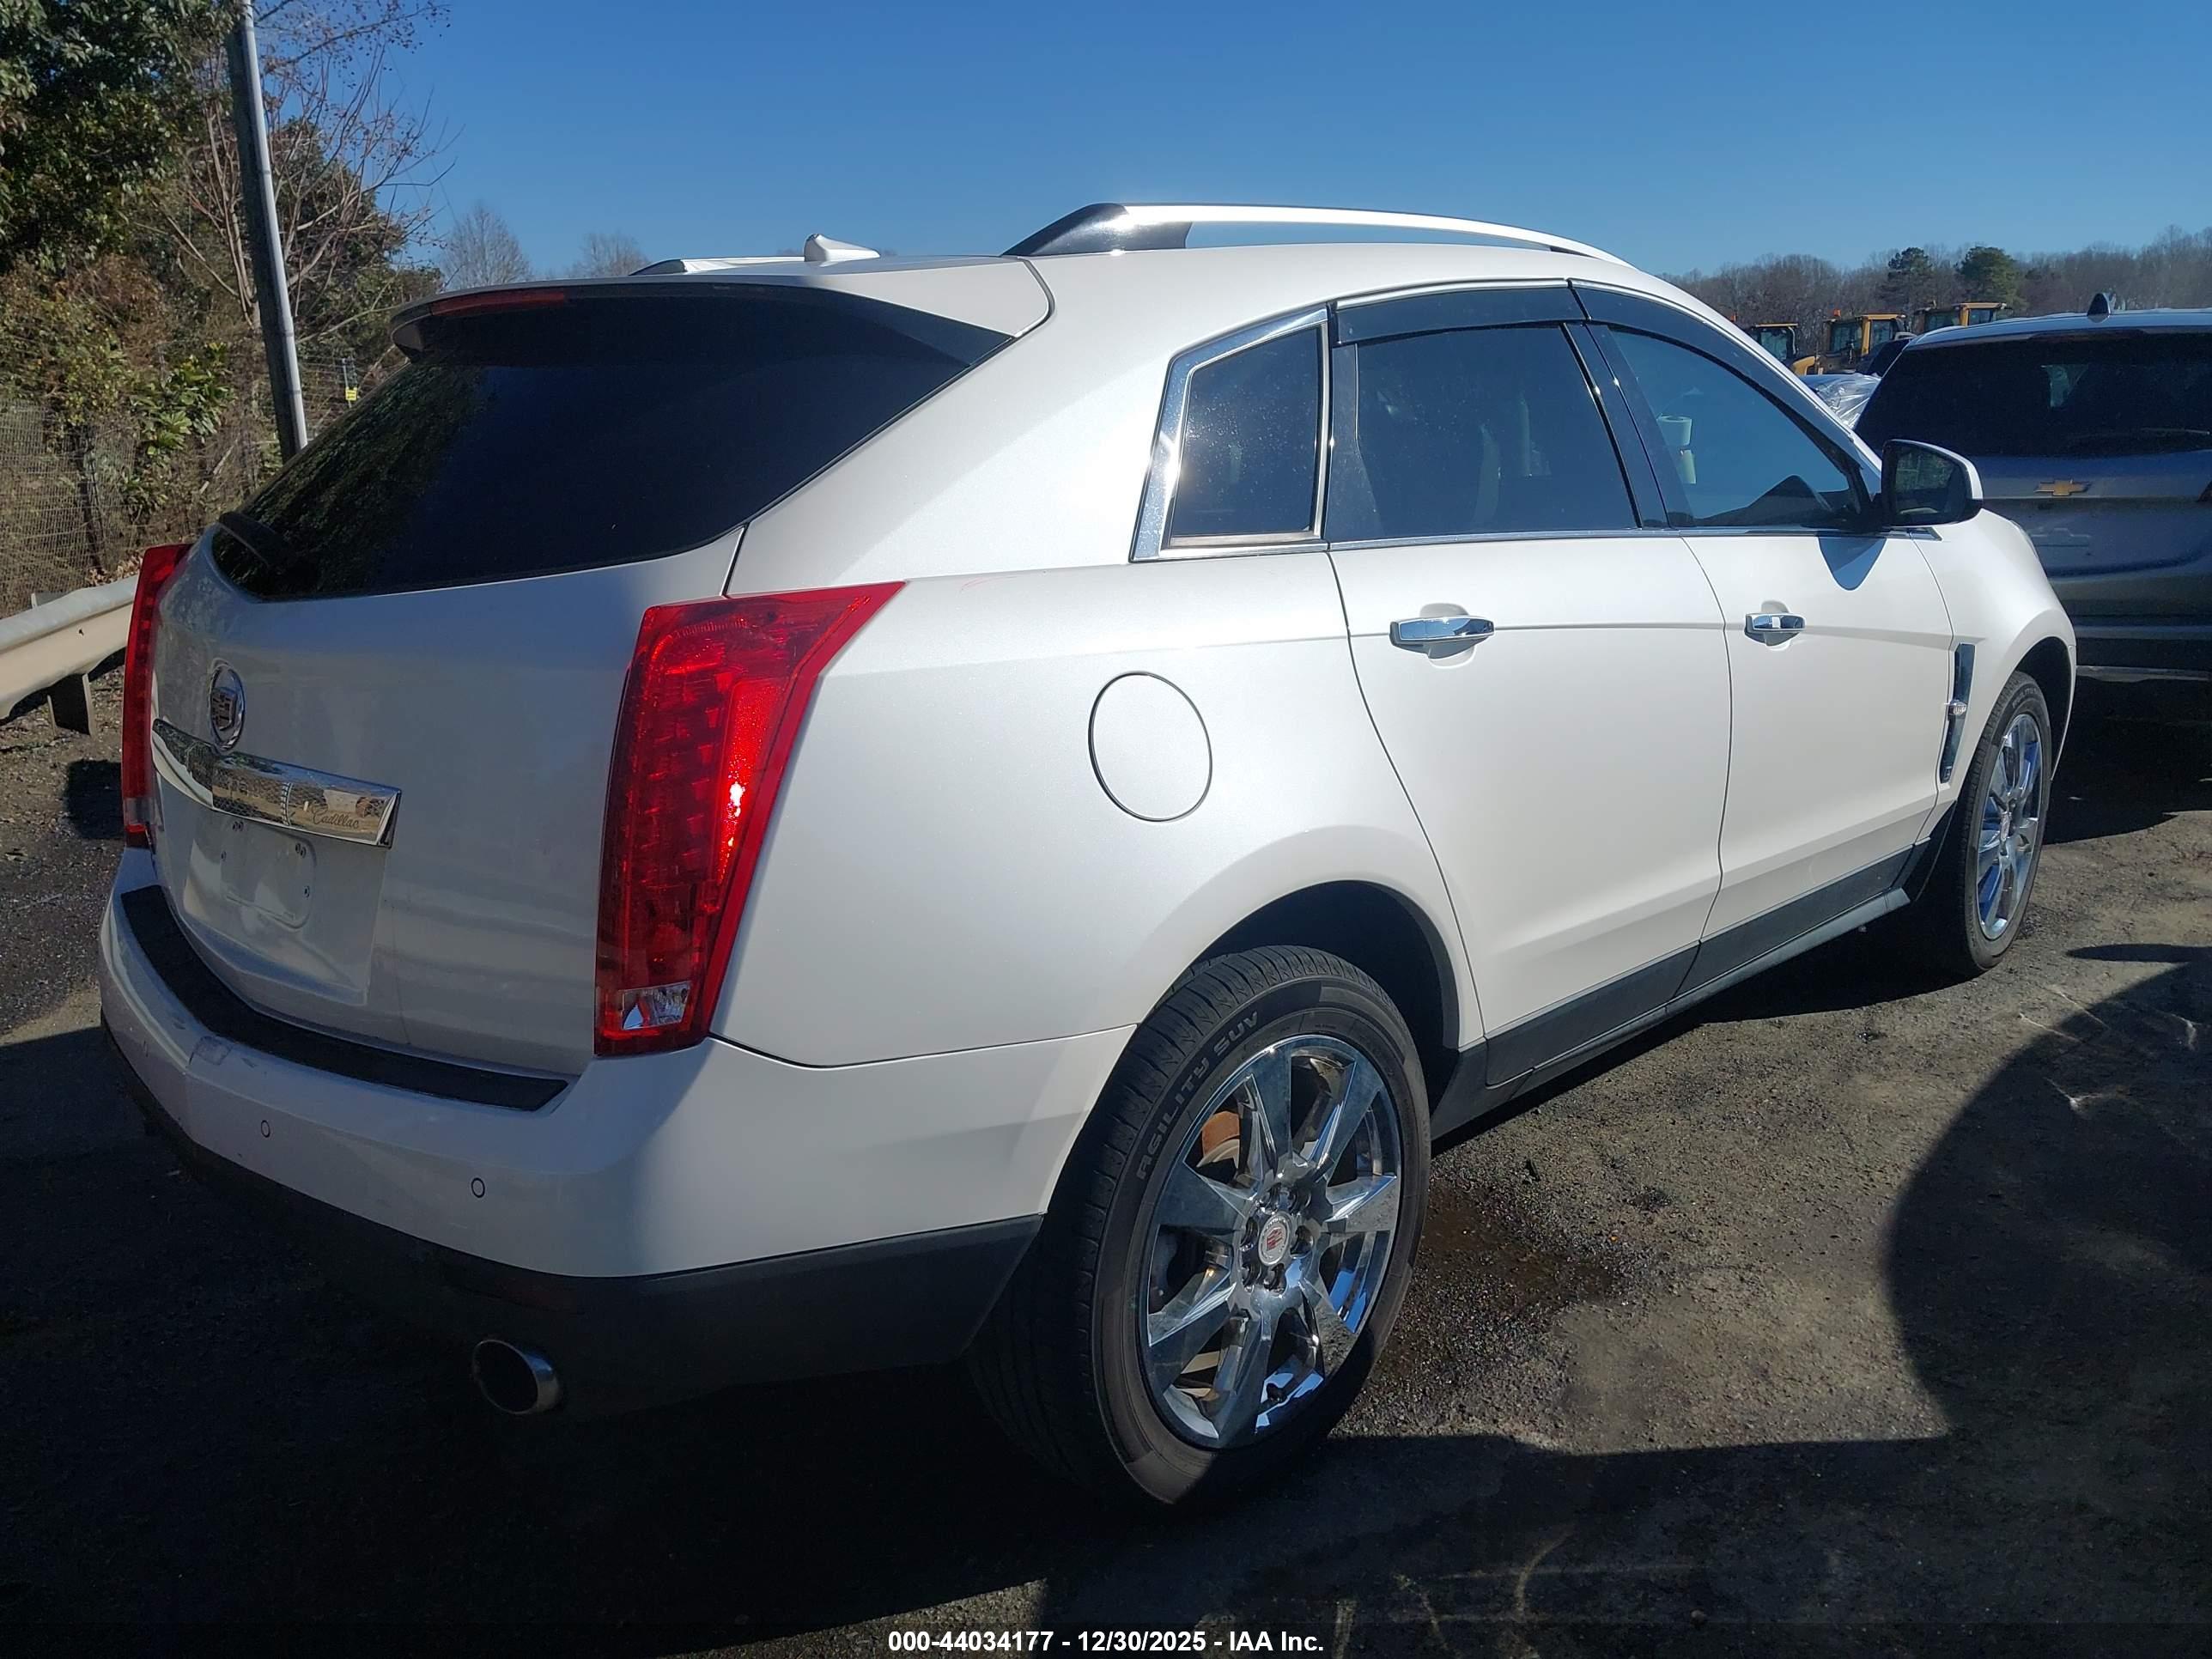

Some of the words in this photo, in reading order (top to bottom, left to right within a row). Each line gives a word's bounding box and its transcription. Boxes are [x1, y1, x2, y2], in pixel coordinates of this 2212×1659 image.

[312, 805, 360, 830] Cadillac
[1136, 1057, 1211, 1180] AGILITY
[1212, 1010, 1258, 1057] SUV
